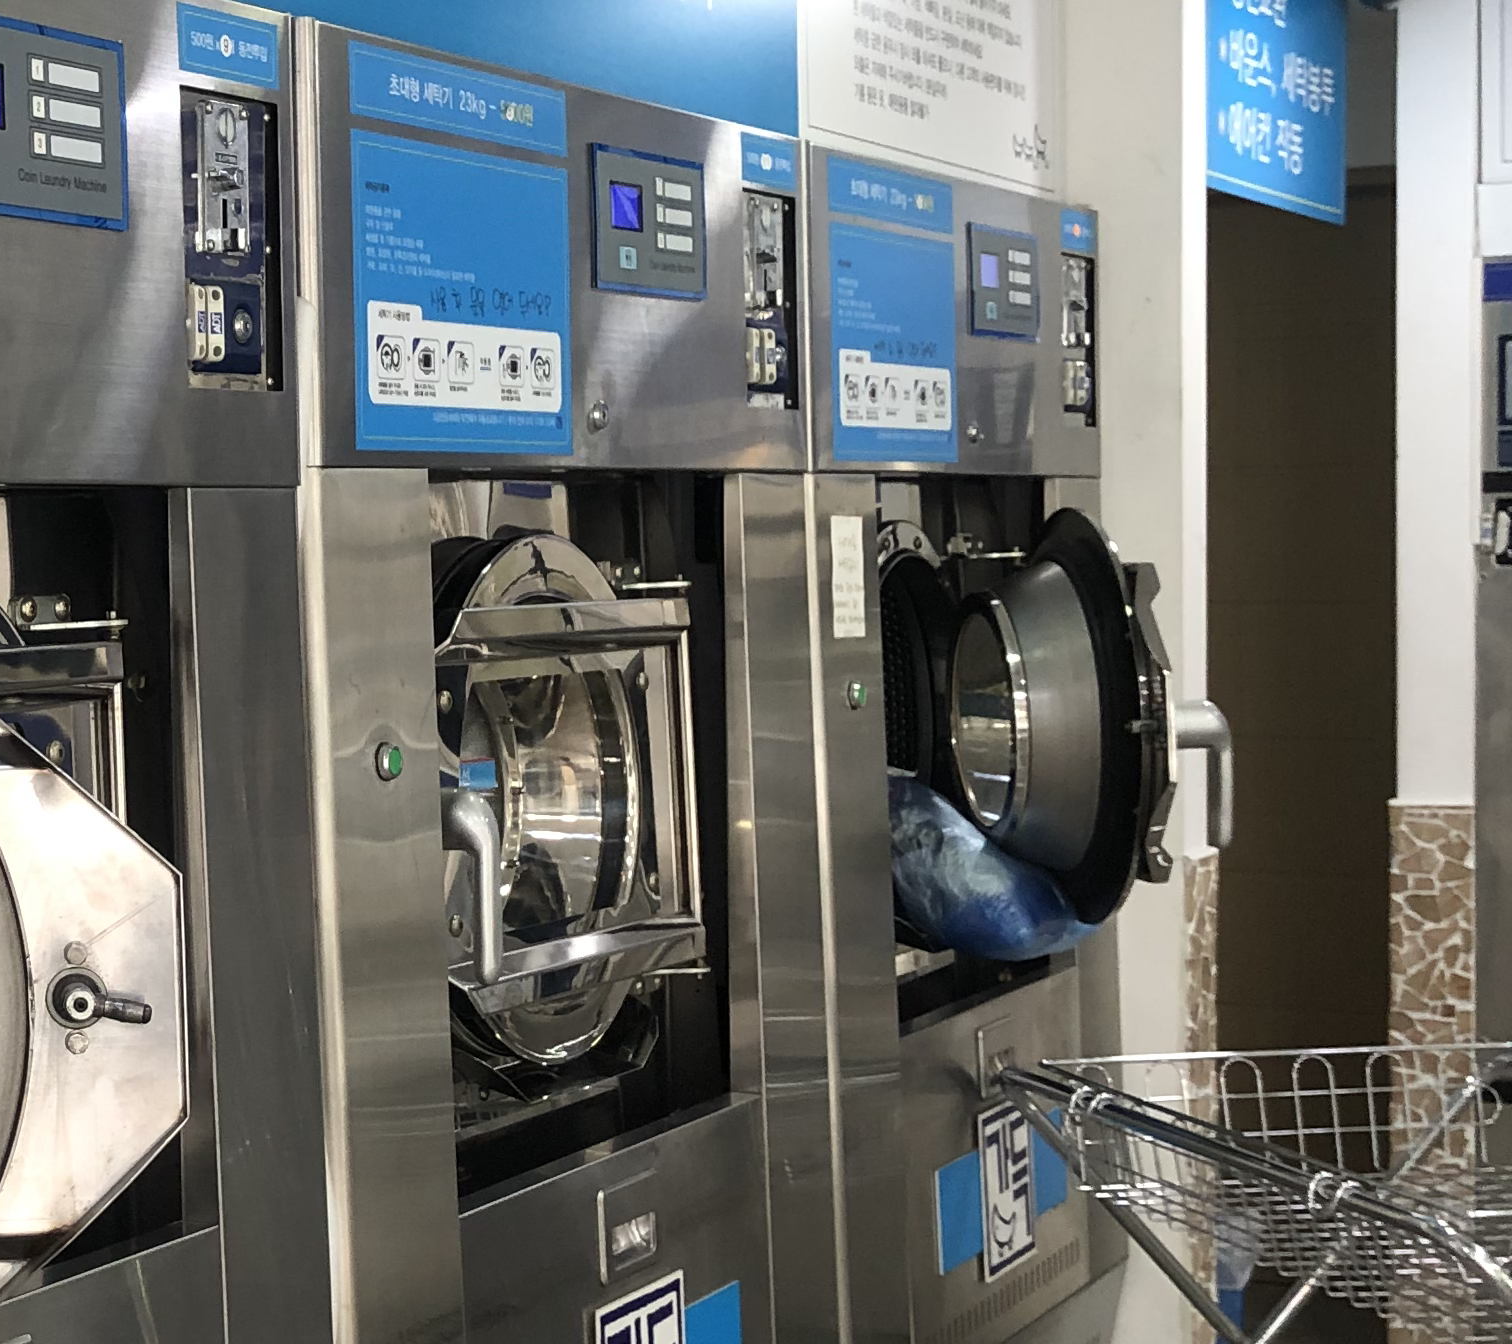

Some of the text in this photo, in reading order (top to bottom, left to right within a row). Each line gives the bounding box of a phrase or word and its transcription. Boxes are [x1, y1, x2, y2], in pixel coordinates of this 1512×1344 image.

[389, 73, 420, 103] 초대형
[423, 82, 453, 110] 세탁기
[459, 90, 486, 120] 23kg
[18, 167, 107, 193] Coin Laundry Machine
[986, 1115, 1030, 1236] 가득
